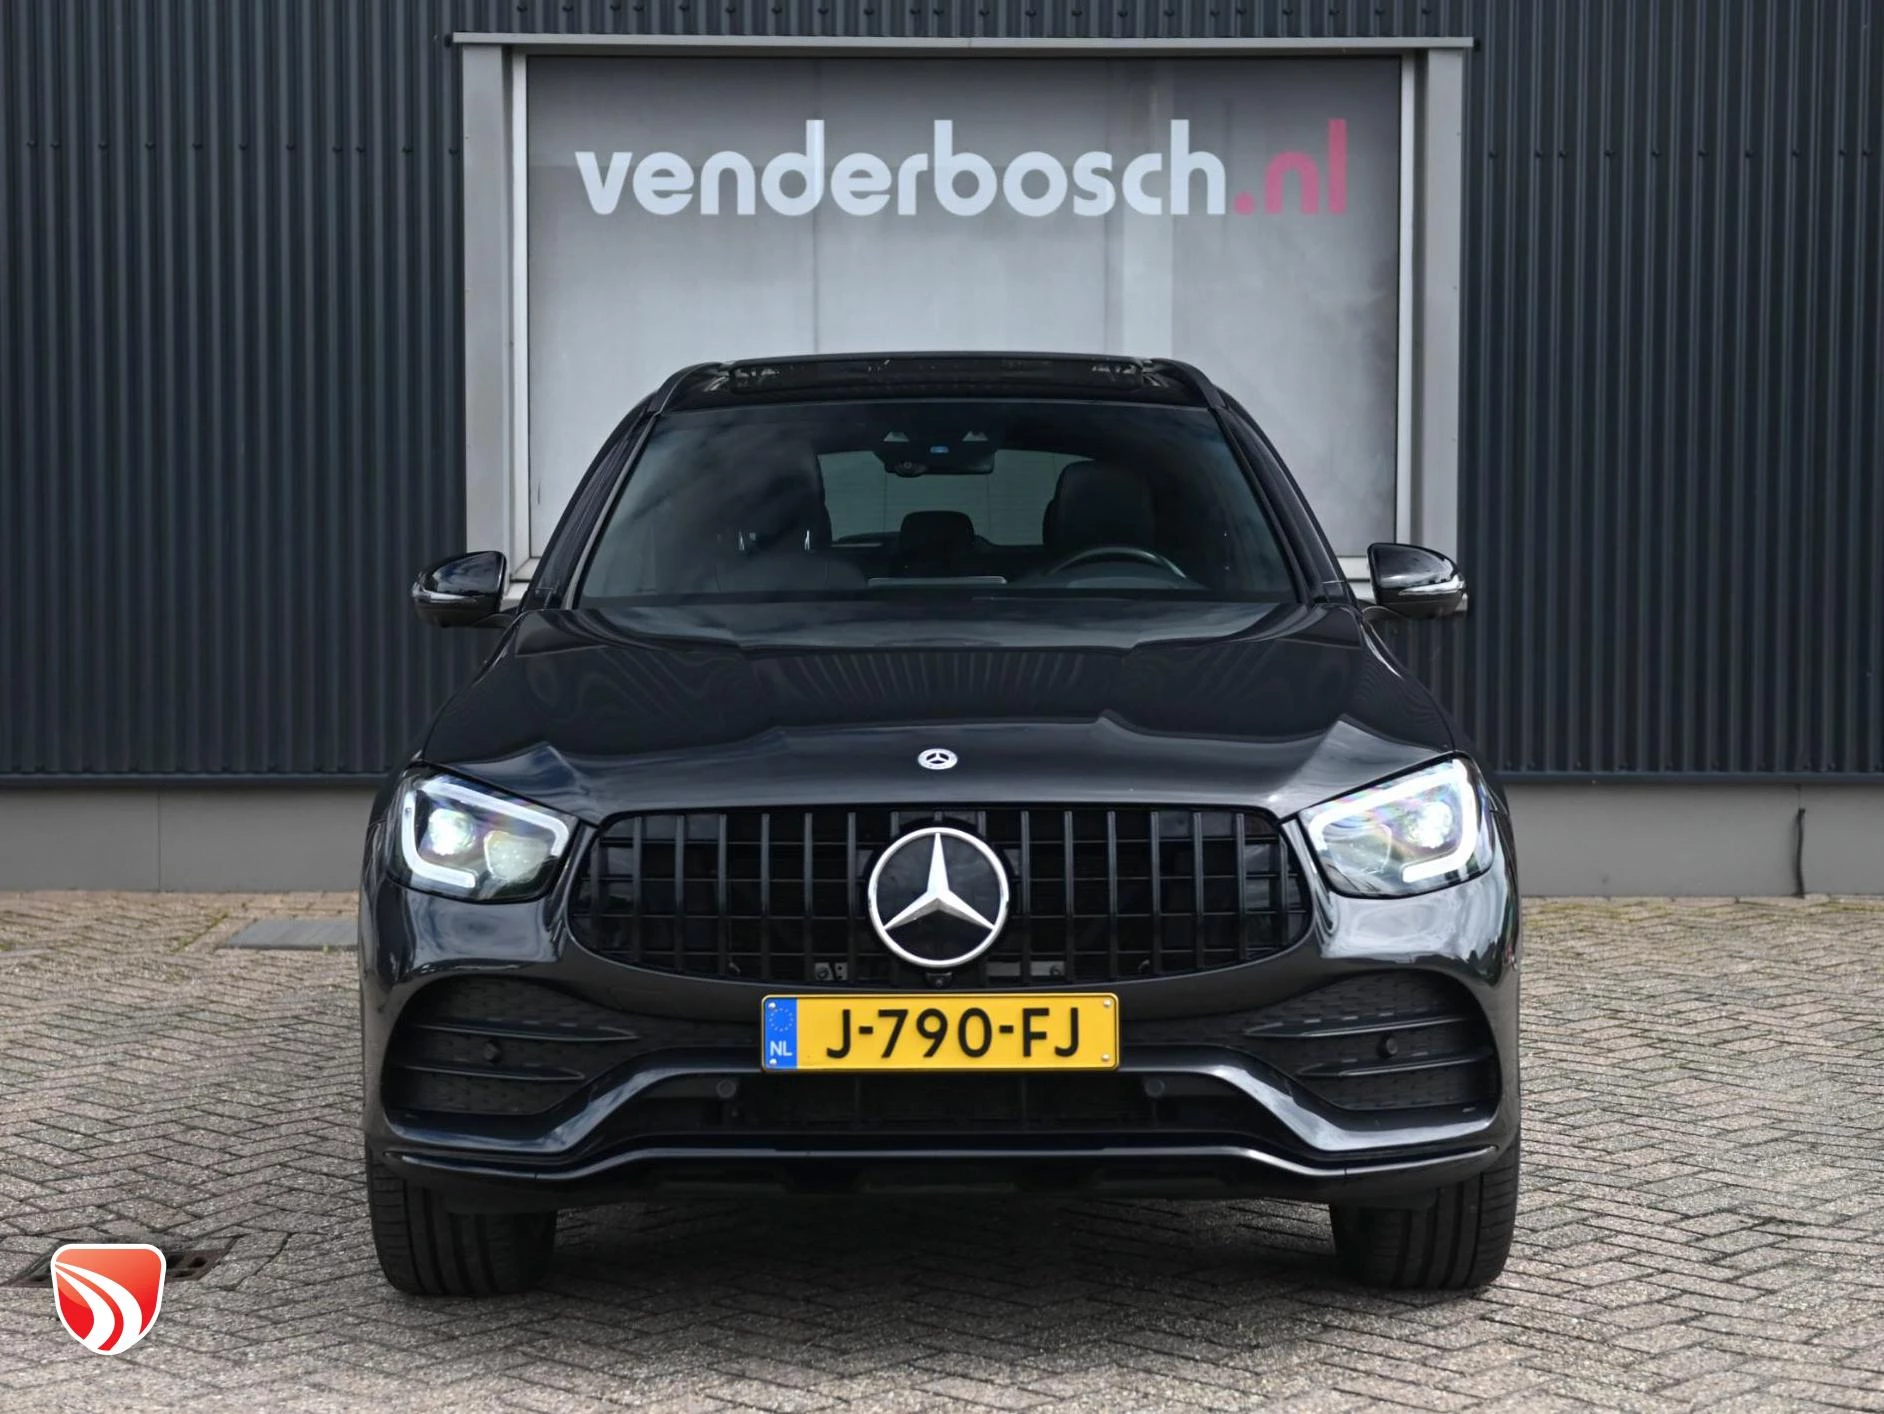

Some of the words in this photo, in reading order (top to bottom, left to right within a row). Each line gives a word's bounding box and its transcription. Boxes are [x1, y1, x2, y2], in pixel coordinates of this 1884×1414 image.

[575, 118, 1348, 217] venderbosch.nl
[769, 1040, 793, 1057] NL
[826, 1007, 1080, 1059] J-790-FJ
